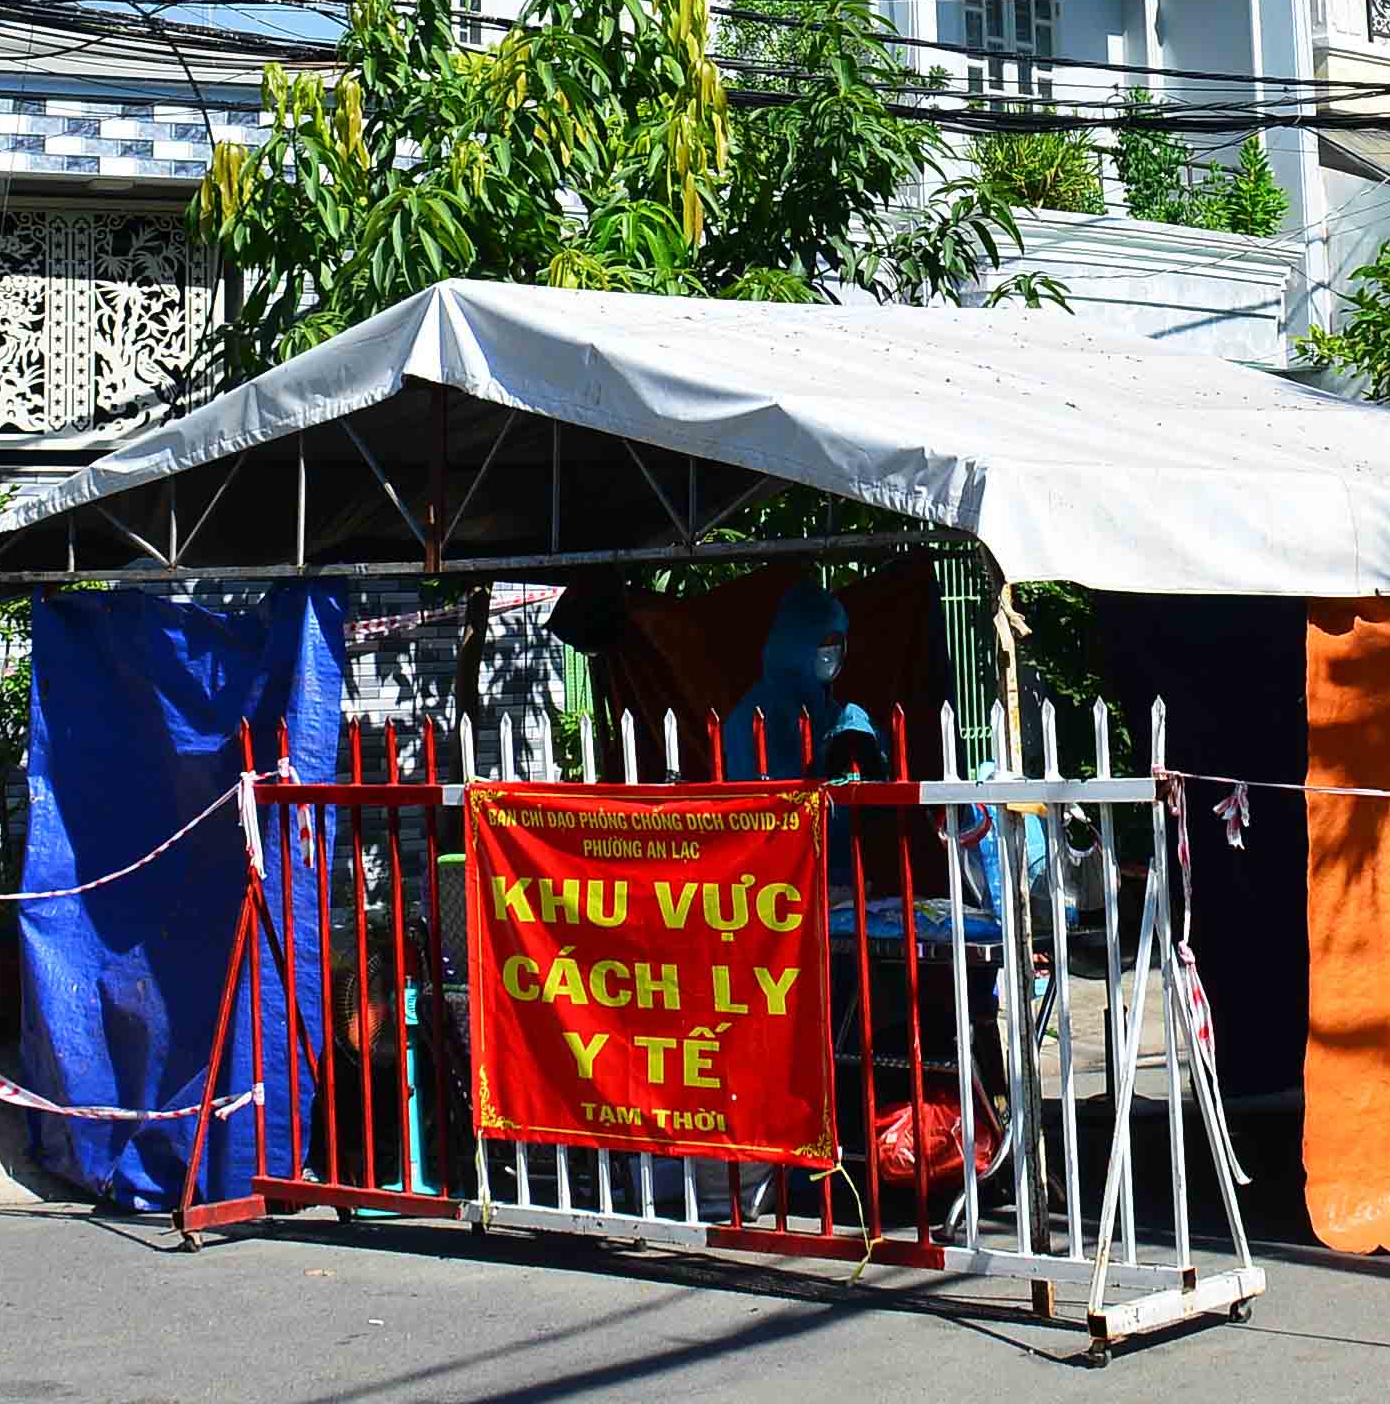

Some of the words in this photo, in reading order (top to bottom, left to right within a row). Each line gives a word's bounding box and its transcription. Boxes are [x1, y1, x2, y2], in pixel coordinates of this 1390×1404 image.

[488, 807, 518, 827] BAN
[686, 811, 724, 834] DỊCH
[728, 810, 800, 831] COVID-19
[583, 836, 643, 859] PHƯỜNG
[647, 840, 667, 860] AN
[671, 840, 701, 865] LẠC
[491, 875, 628, 927] KHU
[653, 873, 803, 942] VỰC
[502, 946, 681, 1011] CÁCH
[712, 965, 802, 1016] LY
[562, 1032, 610, 1080] Y
[633, 1022, 733, 1089] TẾ
[580, 1102, 642, 1127] TẠM
[651, 1107, 727, 1132] THỜI
